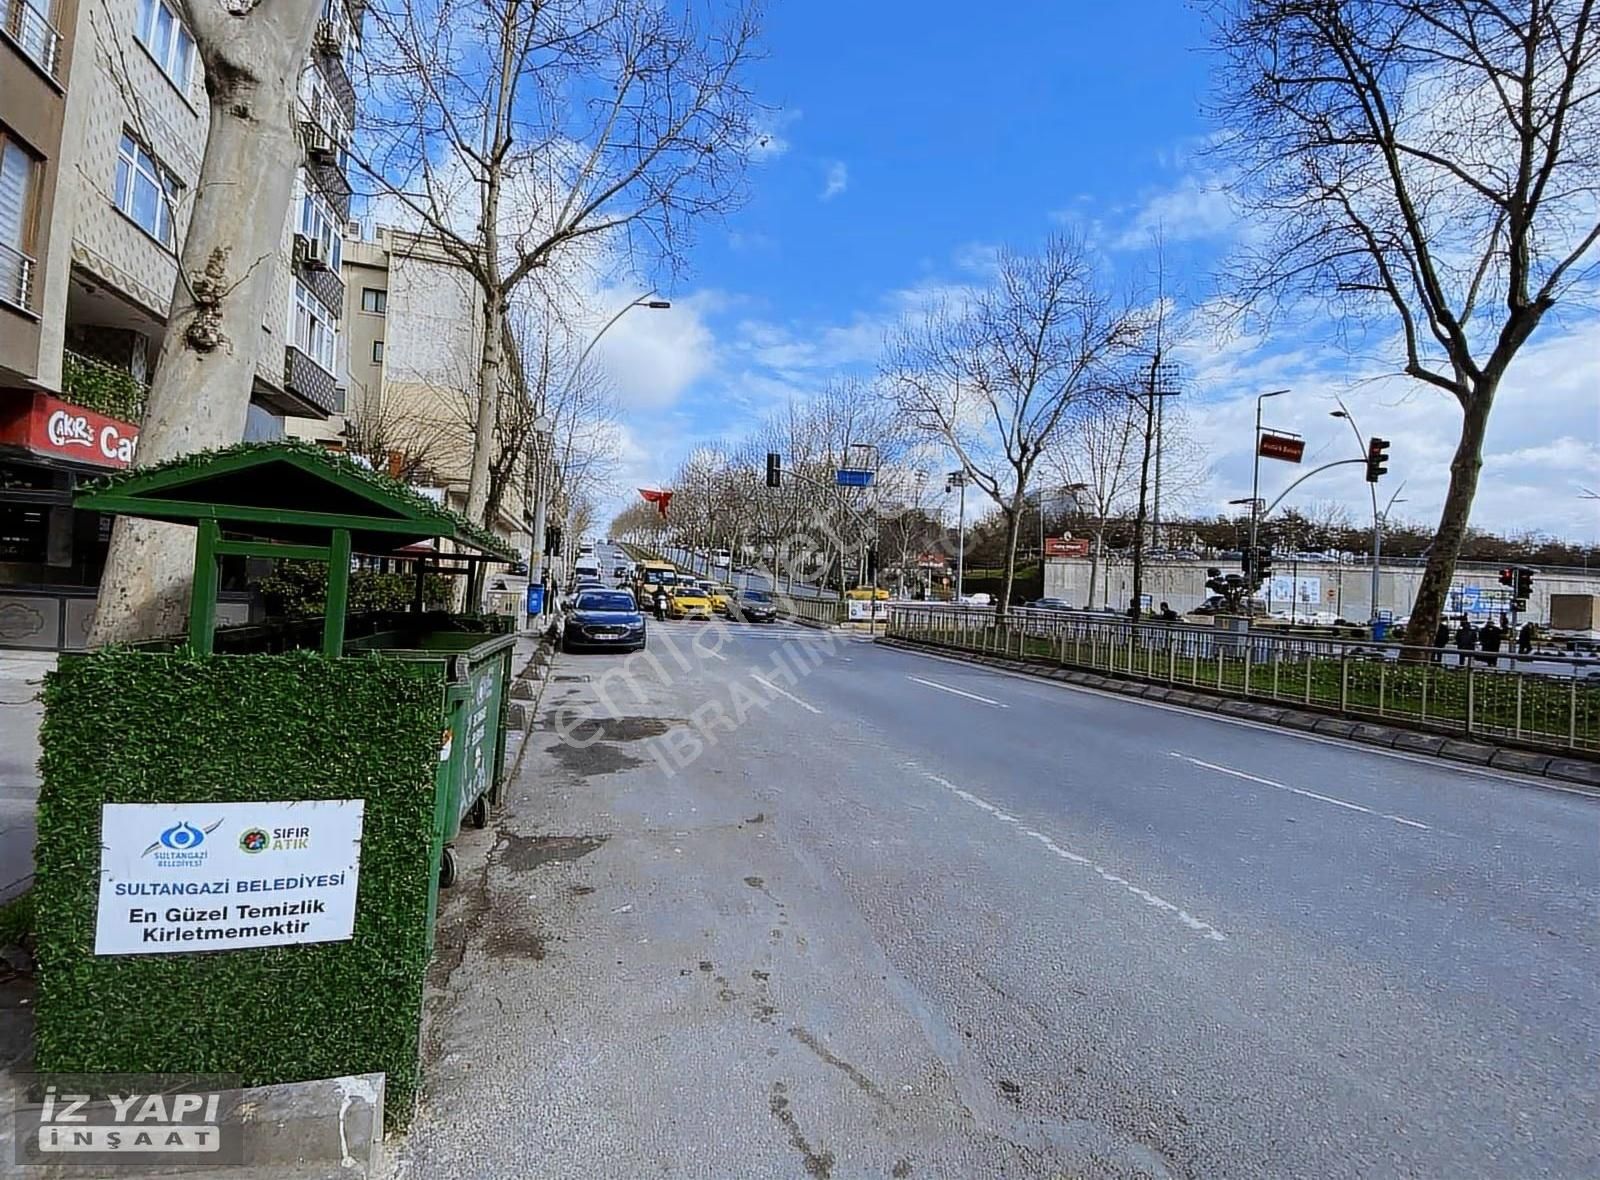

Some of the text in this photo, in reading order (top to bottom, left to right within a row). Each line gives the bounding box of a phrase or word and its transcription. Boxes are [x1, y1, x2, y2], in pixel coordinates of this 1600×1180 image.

[273, 827, 310, 839] SIFIR
[272, 838, 309, 850] ATIK
[154, 851, 208, 859] SULTANGAZİ
[115, 871, 345, 895] SULTANGAZİ BELEDİYESİ
[129, 900, 325, 923] En Güzel Temizlik
[142, 919, 310, 942] Kirletmemektir
